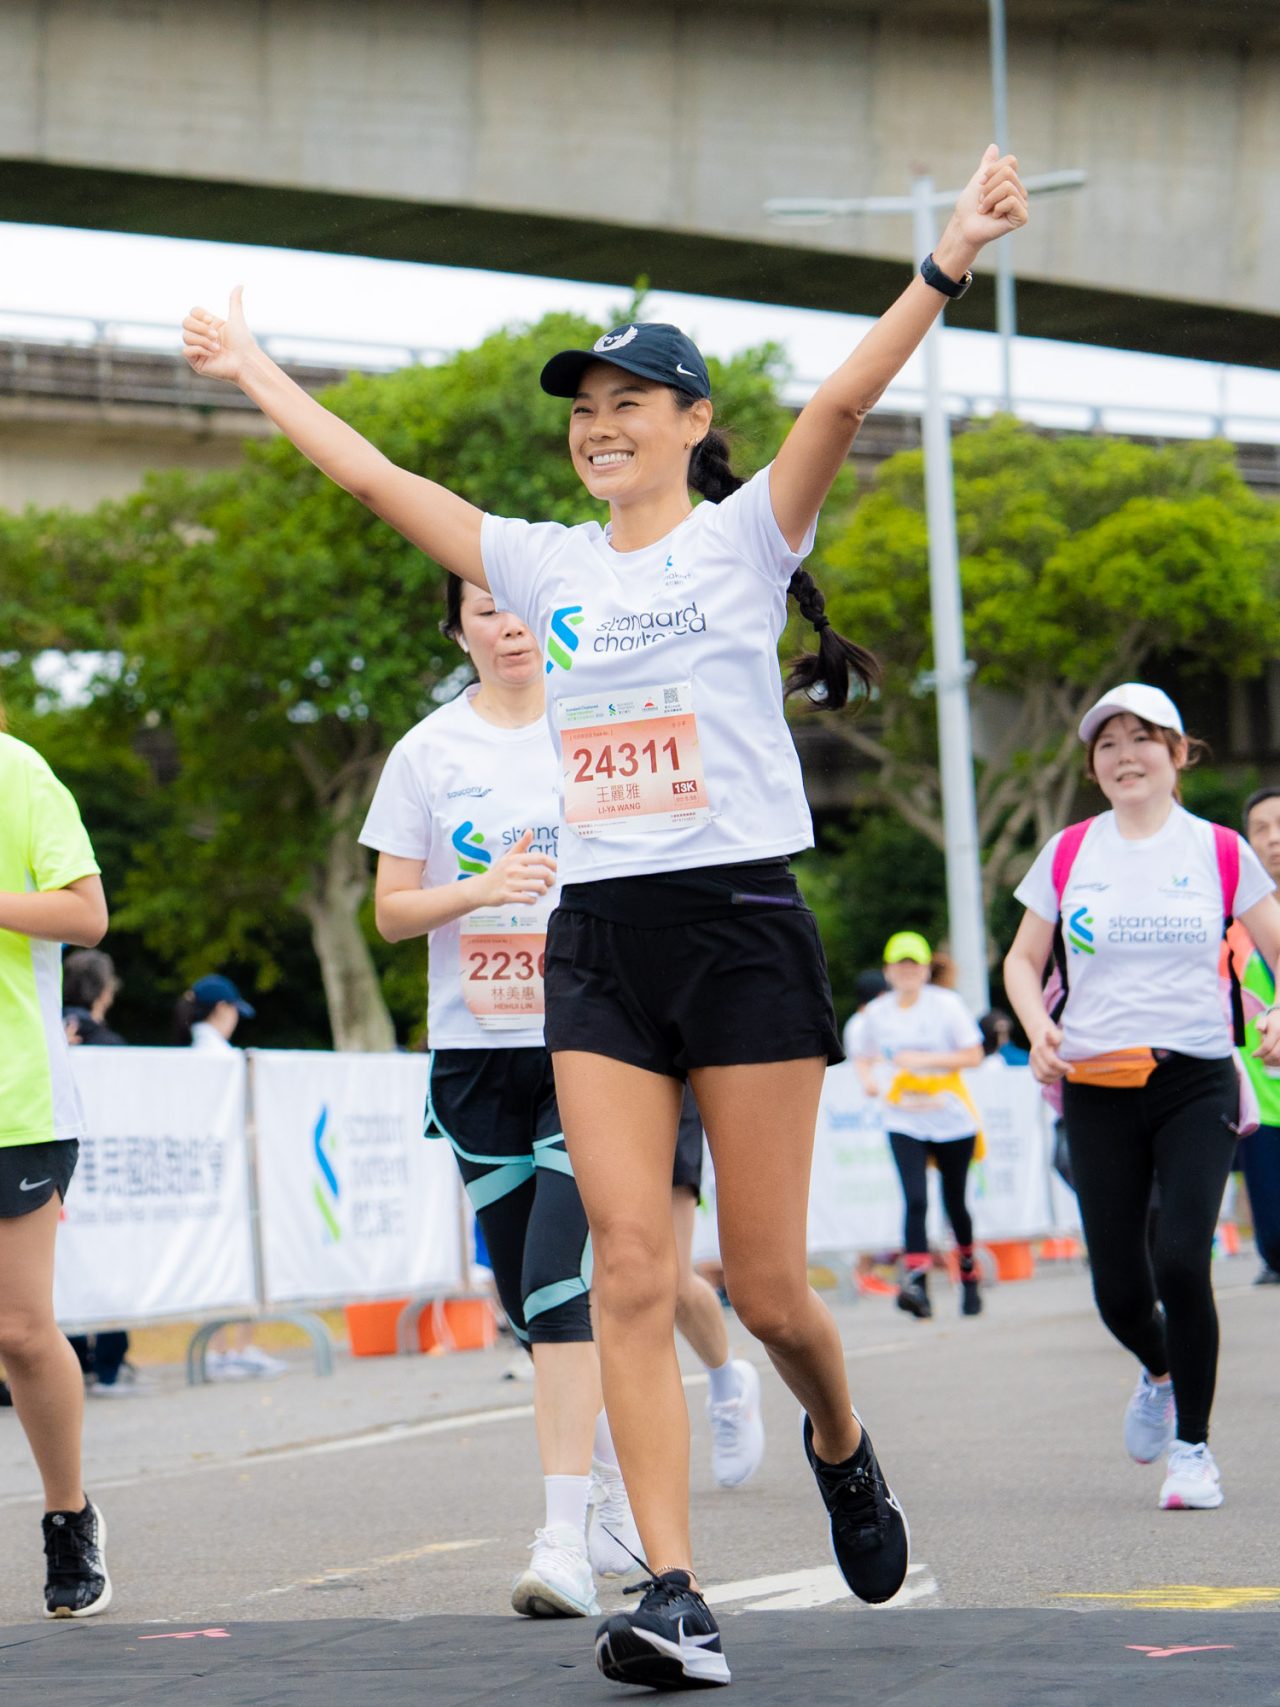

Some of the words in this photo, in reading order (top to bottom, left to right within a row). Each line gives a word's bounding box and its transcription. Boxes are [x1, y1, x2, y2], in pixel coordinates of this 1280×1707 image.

[596, 601, 699, 632] standard
[593, 612, 707, 653] chartd
[572, 736, 680, 784] 24311
[596, 783, 641, 804] 王麗雅
[674, 782, 696, 794] 13K
[598, 804, 616, 815] LI-YA
[617, 802, 641, 812] WANG
[1108, 914, 1202, 930] standard
[1107, 928, 1207, 944] chartered
